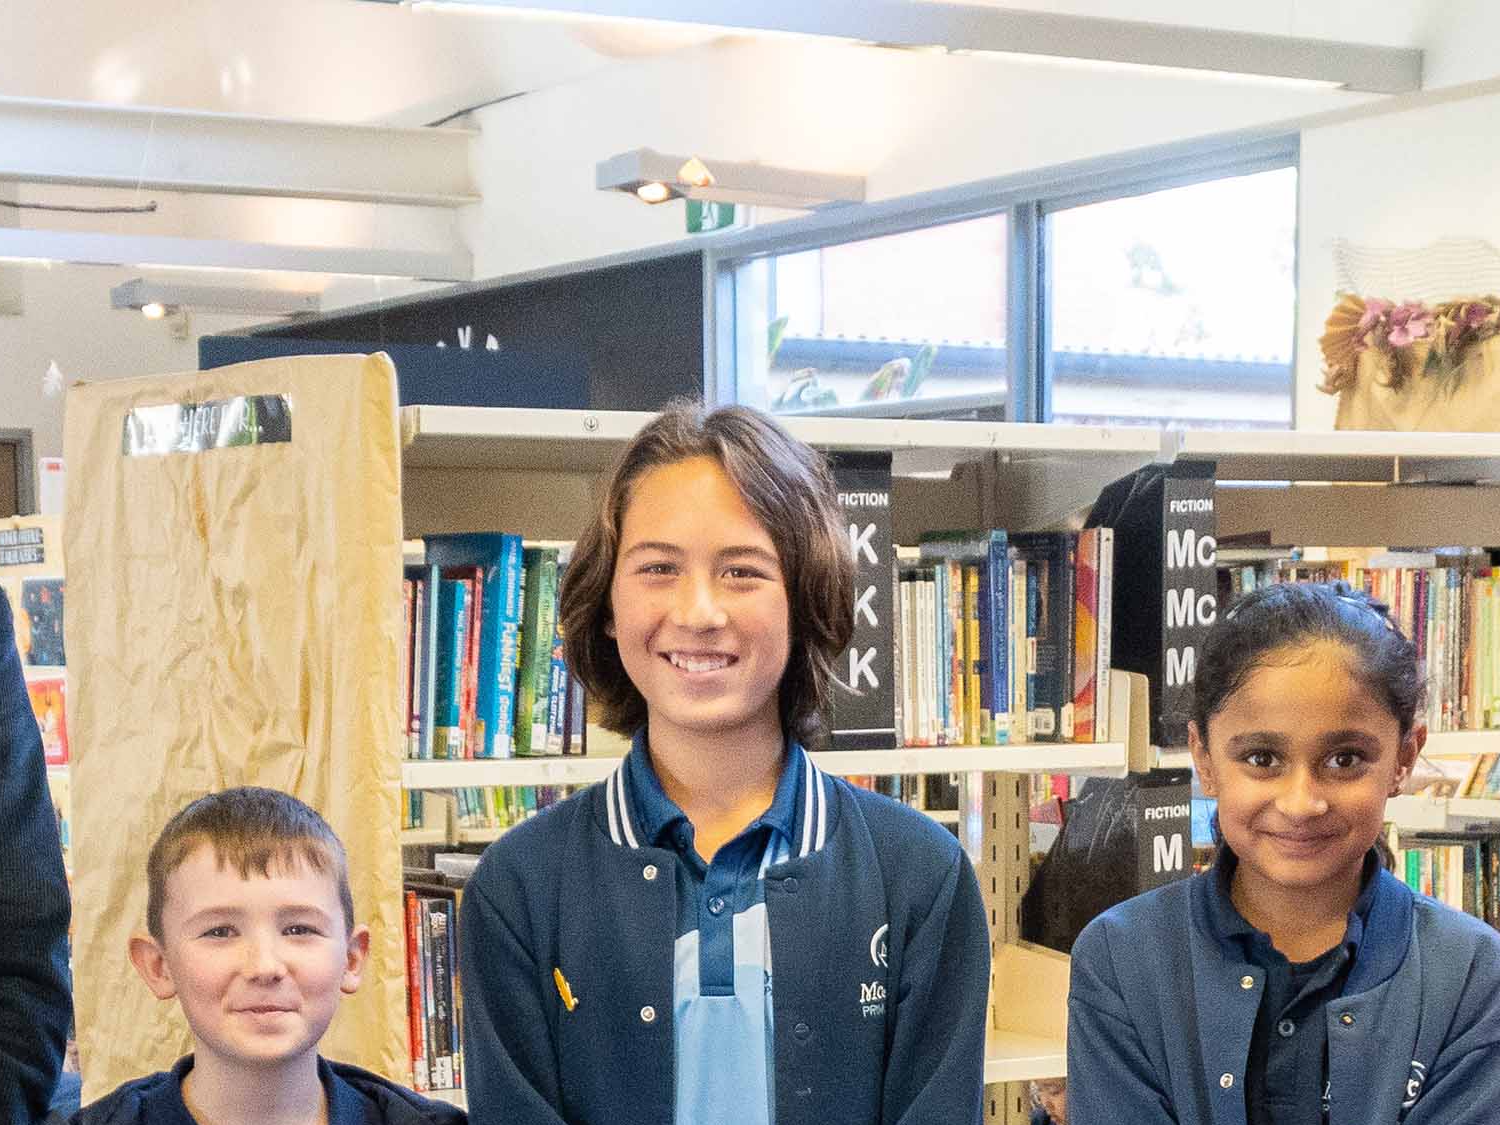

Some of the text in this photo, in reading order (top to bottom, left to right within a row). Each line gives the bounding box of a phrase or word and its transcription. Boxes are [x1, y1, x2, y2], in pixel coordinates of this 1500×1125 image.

[837, 491, 889, 507] FICTION
[1170, 498, 1214, 514] FICTION
[849, 522, 879, 565] K
[1166, 528, 1218, 569] Mc
[854, 583, 879, 627] K
[1166, 587, 1218, 628] Mc
[498, 621, 517, 693] FUNNIEST
[848, 646, 880, 689] K
[1144, 804, 1190, 820] FICTION
[1153, 833, 1183, 873] M
